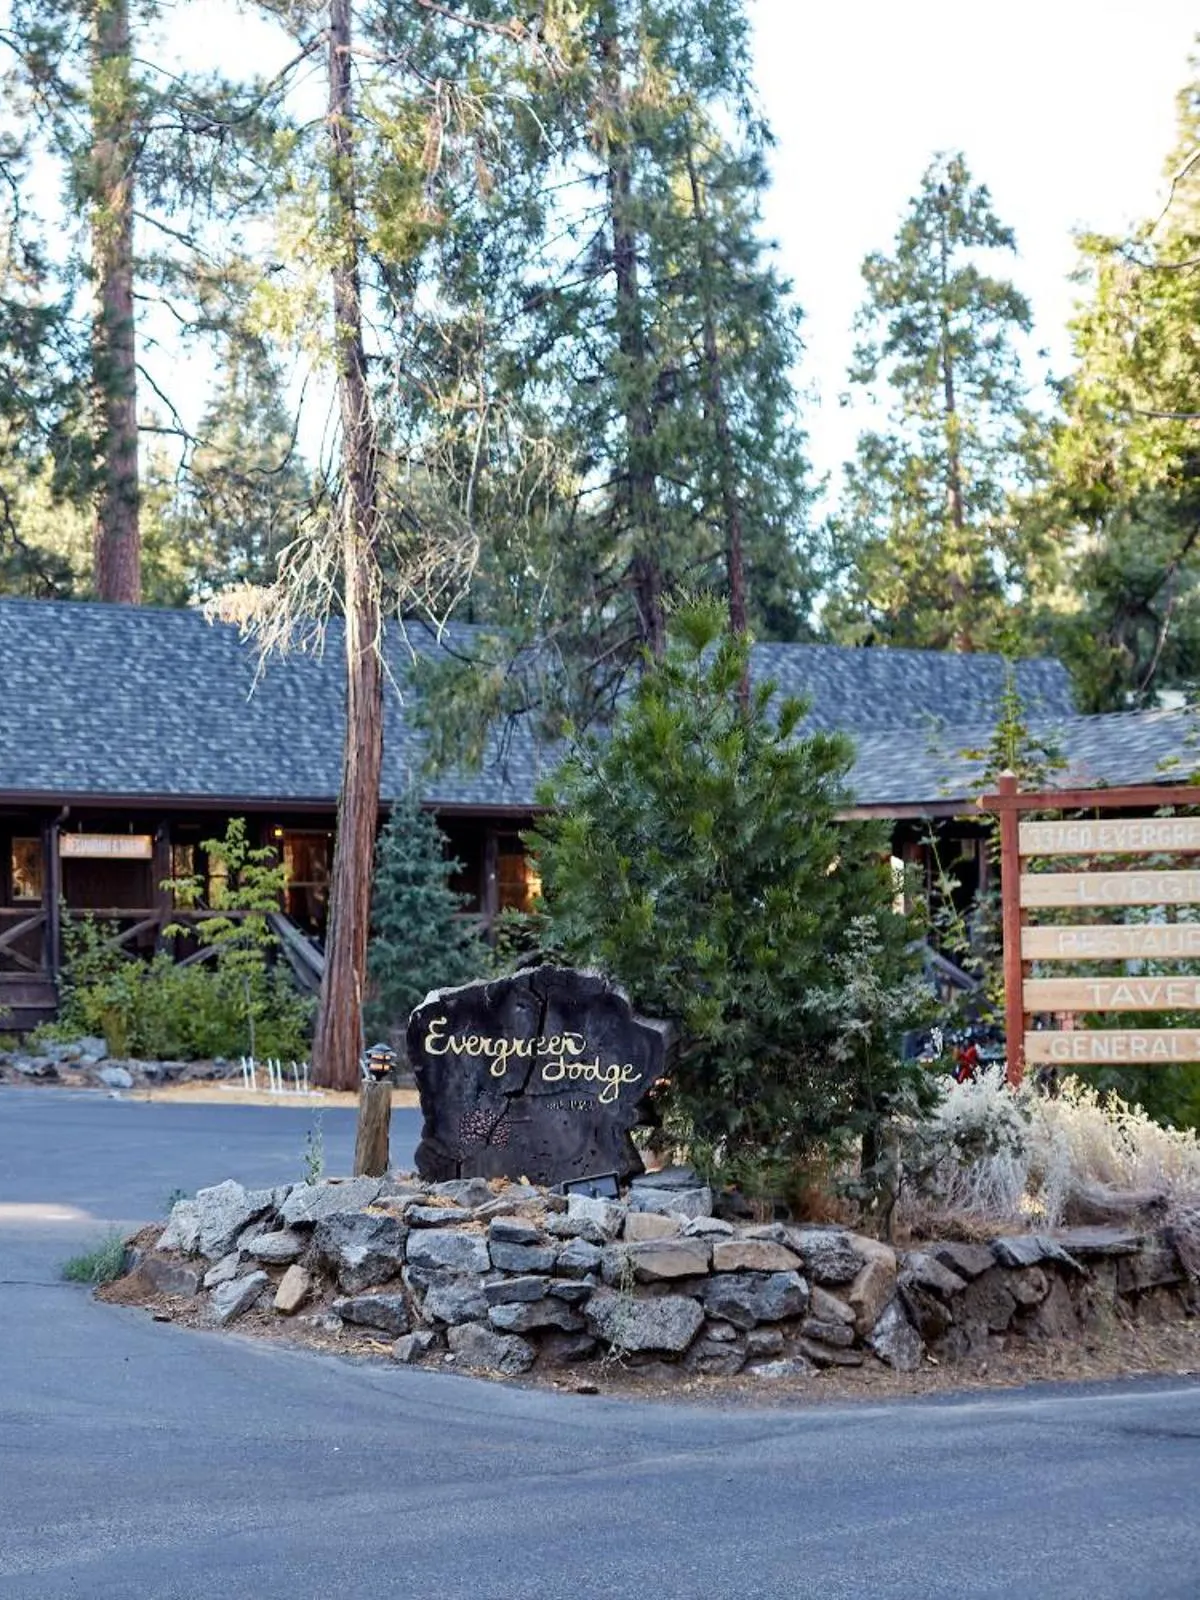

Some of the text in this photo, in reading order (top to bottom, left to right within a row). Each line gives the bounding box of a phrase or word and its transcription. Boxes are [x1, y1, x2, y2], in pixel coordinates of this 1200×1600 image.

[1086, 982, 1200, 1007] TAVE
[425, 1017, 587, 1077] Evergreen
[1051, 1036, 1187, 1060] GENERAL
[542, 1056, 642, 1104] Lodge
